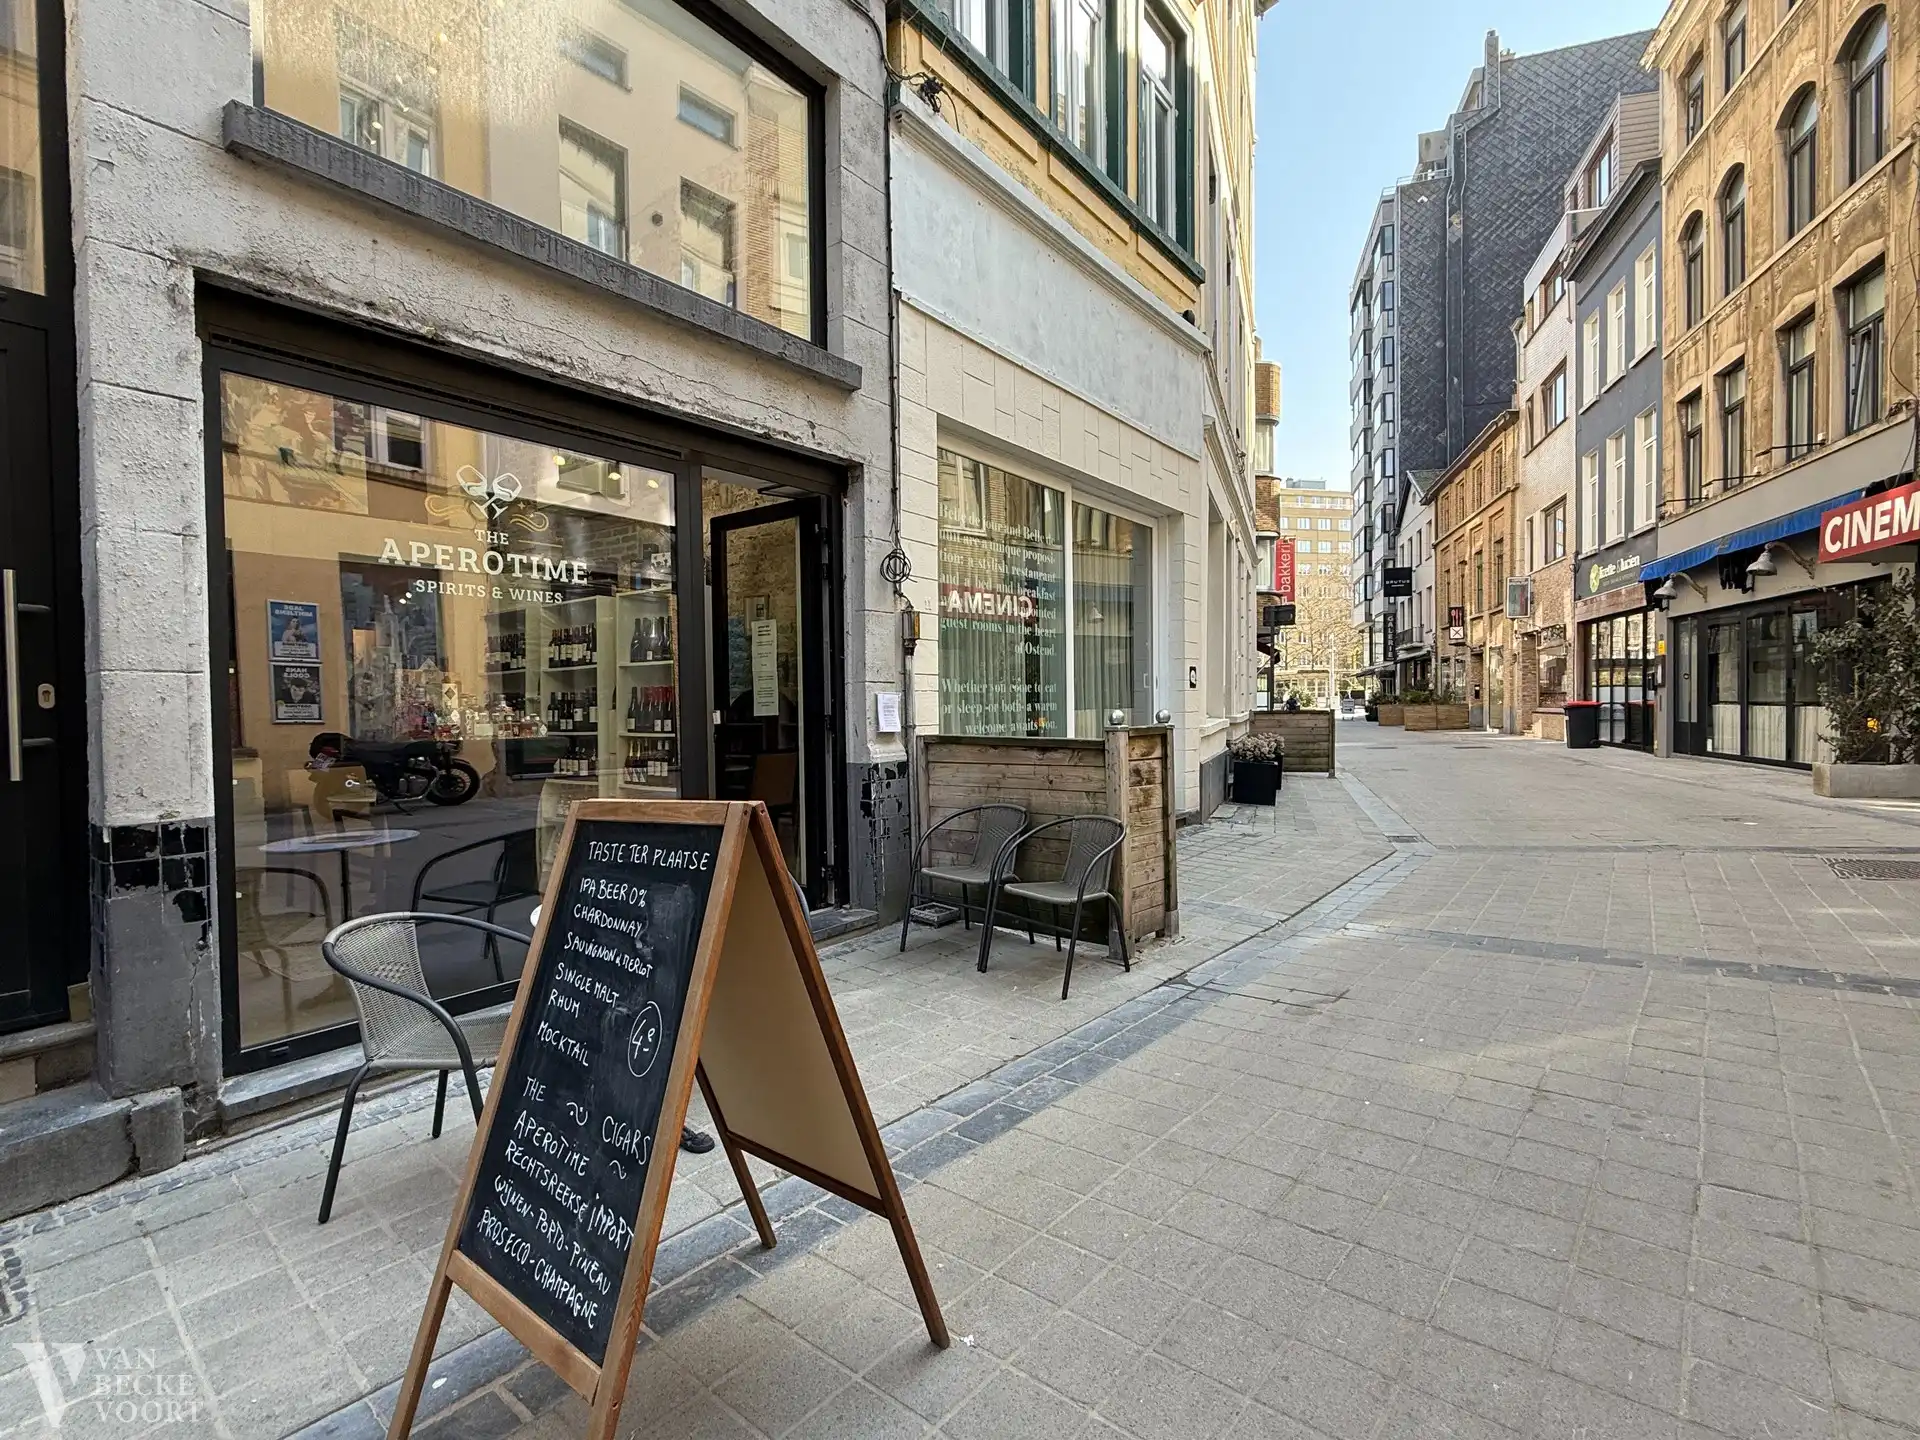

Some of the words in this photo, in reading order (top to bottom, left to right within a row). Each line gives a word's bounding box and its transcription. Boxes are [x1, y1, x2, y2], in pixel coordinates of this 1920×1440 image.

[475, 528, 509, 546] THE
[1023, 525, 1045, 544] Belle
[378, 538, 588, 585] APEROTIME
[979, 556, 1009, 574] stylish
[1012, 565, 1056, 583] restaurant
[416, 580, 486, 598] SPIRITS
[492, 586, 503, 599] &
[509, 587, 563, 604] WINES
[976, 575, 992, 591] bed
[1017, 582, 1056, 601] breakfast
[940, 618, 968, 632] guest
[972, 620, 1003, 633] rooms
[1005, 620, 1015, 634] in
[1017, 622, 1032, 636] the
[1034, 623, 1056, 638] heart
[941, 678, 987, 693] Whether
[1045, 681, 1057, 693] eat
[942, 703, 953, 714] or
[957, 699, 983, 717] sleep
[1027, 703, 1032, 712] a
[1035, 702, 1057, 712] warm
[965, 720, 1007, 735] welcome
[1010, 717, 1039, 733] awaits
[588, 840, 627, 863] TASTE
[628, 844, 649, 865] TER
[652, 848, 710, 871] PLAATSE
[579, 877, 596, 896] IPA
[597, 878, 628, 901] BEER
[628, 888, 649, 908] 0%
[573, 903, 643, 938] CHARDONNAY
[555, 961, 592, 994] SINGLE
[593, 978, 620, 1009] MALT
[548, 988, 581, 1019] RHUM
[522, 1076, 546, 1102] THE
[602, 1115, 651, 1166] CIGARS
[505, 1139, 589, 1223] RECHTSREEKSE
